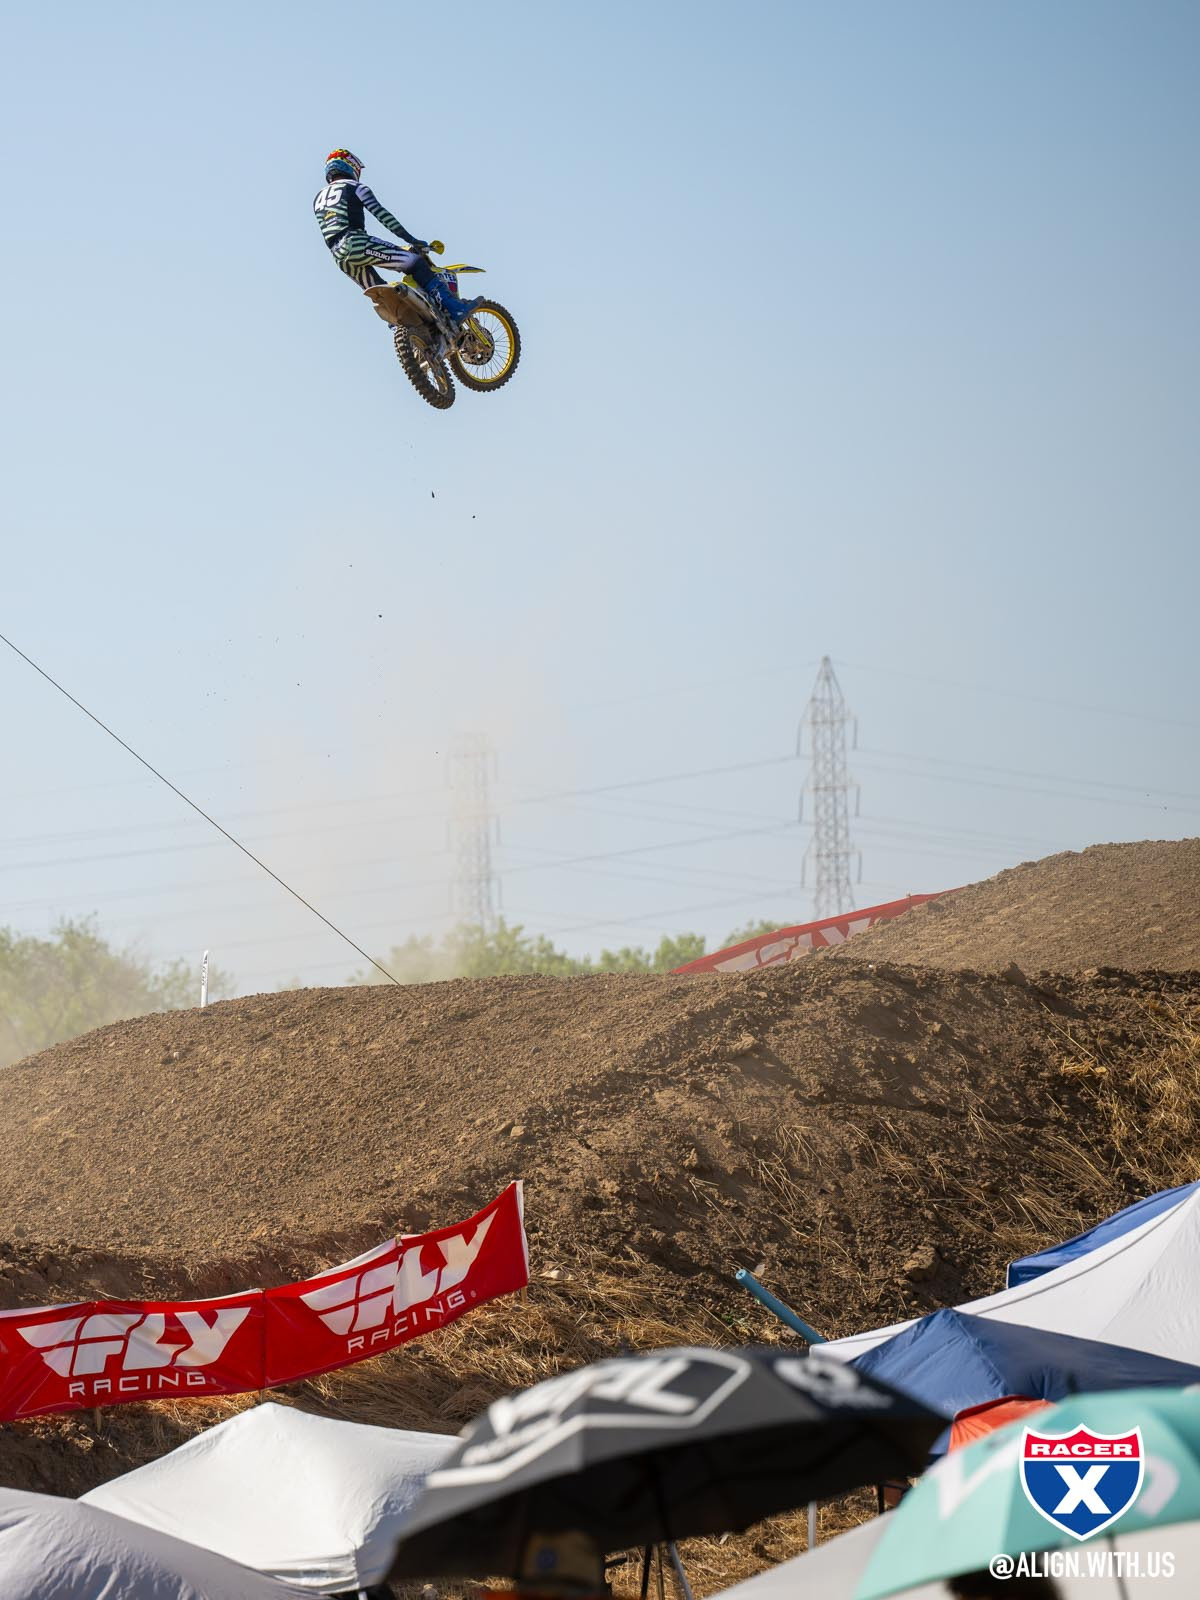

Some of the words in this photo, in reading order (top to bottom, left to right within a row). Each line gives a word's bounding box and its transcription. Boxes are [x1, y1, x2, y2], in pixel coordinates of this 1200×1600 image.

[315, 183, 343, 211] 45
[365, 248, 392, 261] SUZUKI
[300, 1208, 499, 1336] FLY
[16, 1307, 252, 1379] FLY
[347, 1290, 466, 1354] RACING
[69, 1371, 207, 1399] RACING
